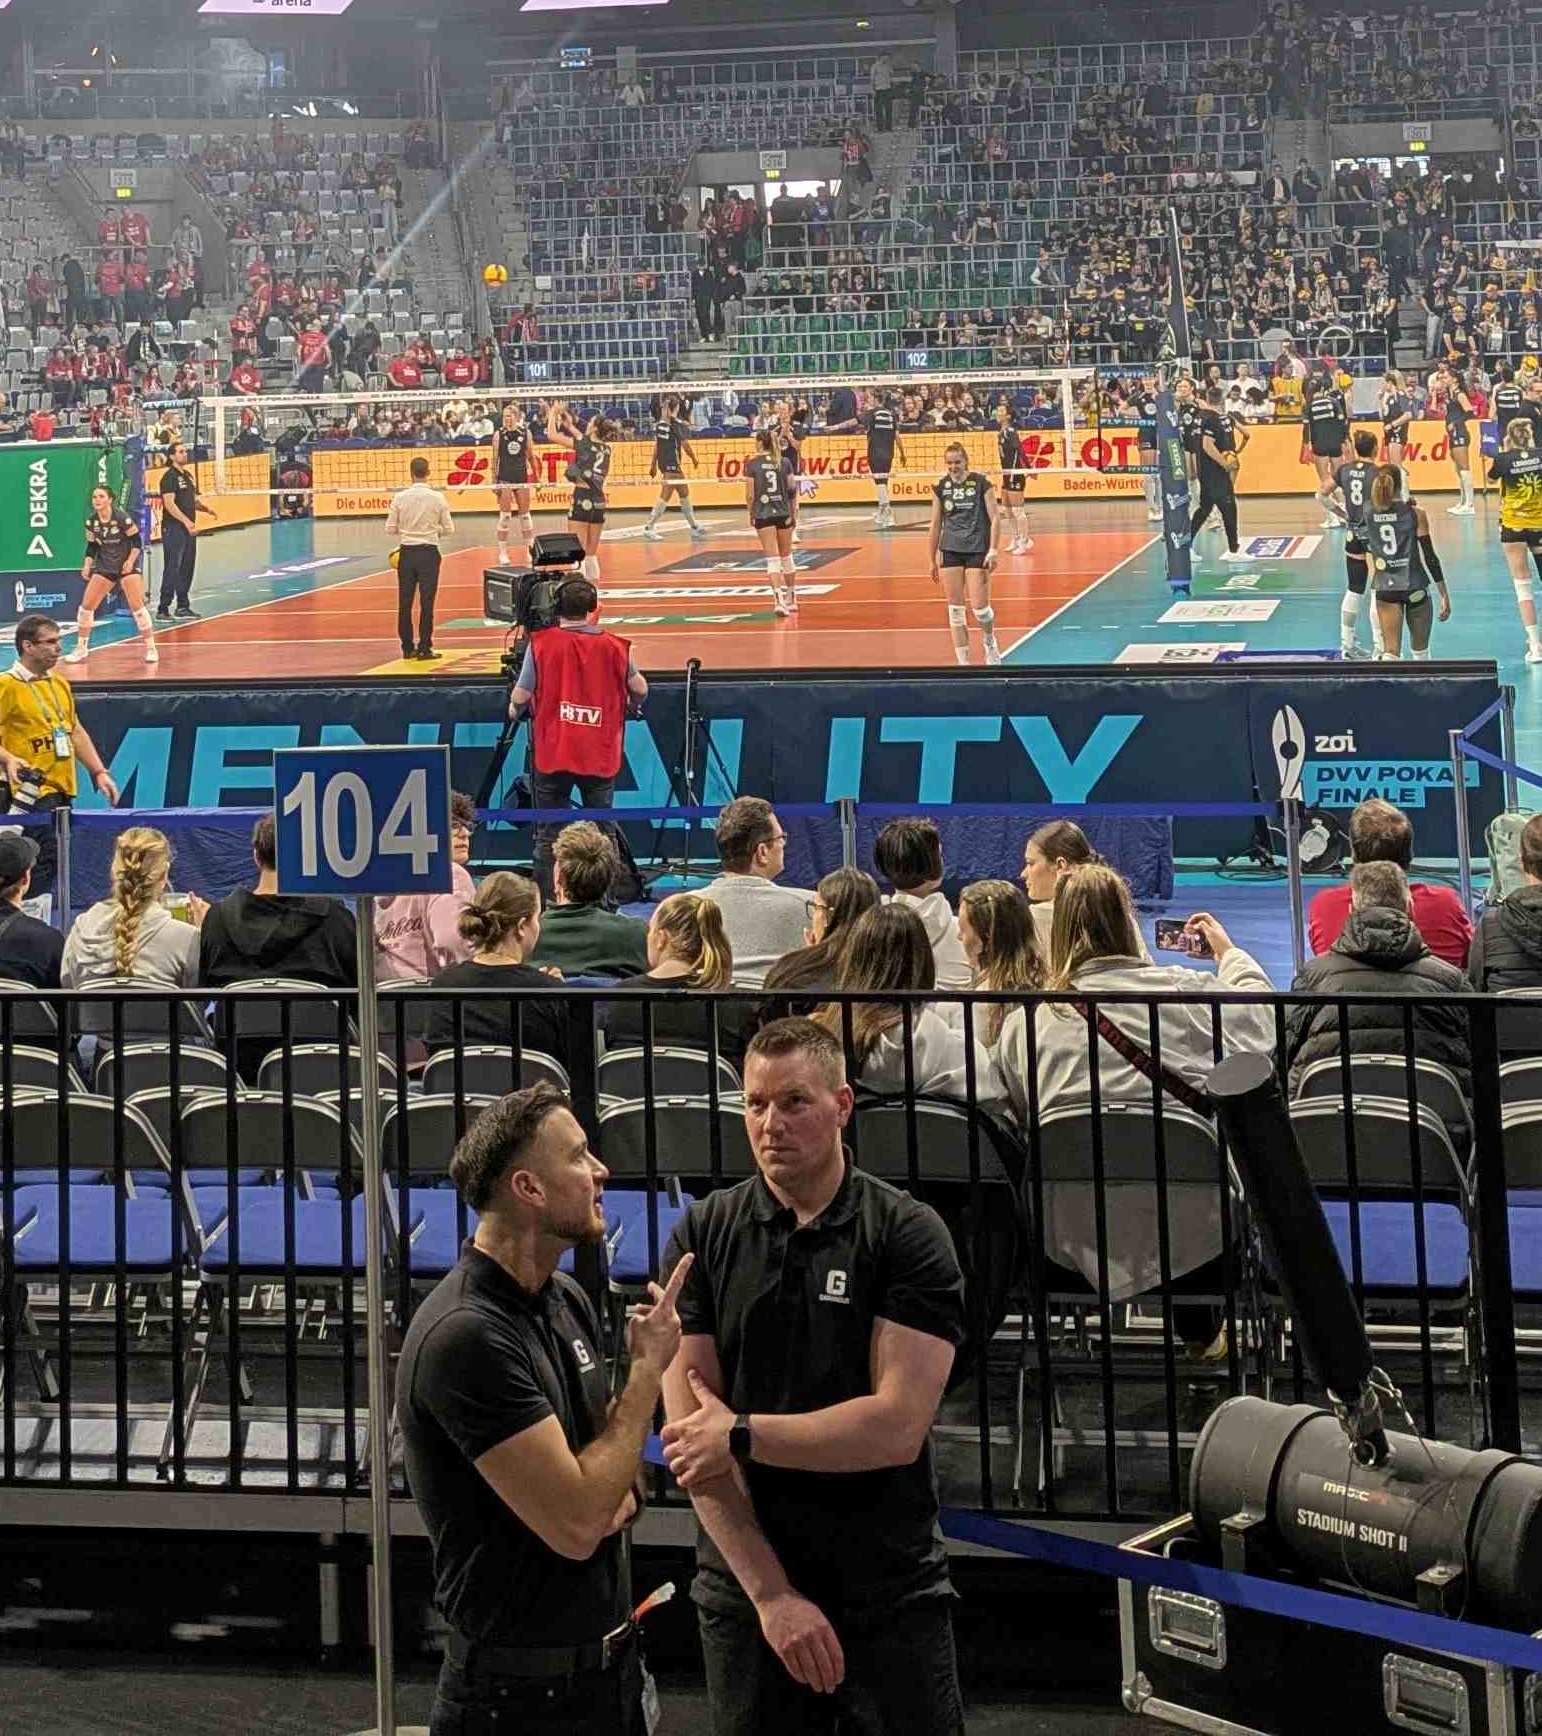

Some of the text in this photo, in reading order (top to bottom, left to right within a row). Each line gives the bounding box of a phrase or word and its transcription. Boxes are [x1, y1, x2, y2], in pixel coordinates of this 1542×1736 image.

[906, 351, 928, 366] 102
[528, 363, 549, 377] 101
[592, 452, 605, 473] 2
[764, 469, 778, 493] 3
[891, 482, 914, 495] Die
[1350, 479, 1363, 505] 8
[29, 457, 48, 528] DEKRA
[335, 497, 356, 510] Die
[952, 487, 965, 500] 25
[103, 527, 109, 538] 7
[1379, 524, 1397, 555] 9
[1314, 729, 1357, 753] zoi
[1316, 765, 1471, 783] DVV POKA
[1316, 786, 1418, 806] FINALE
[283, 769, 439, 877] 104
[826, 1270, 847, 1296] G
[572, 1339, 590, 1364] G
[1295, 1507, 1409, 1554] STADIUM SHOT II
